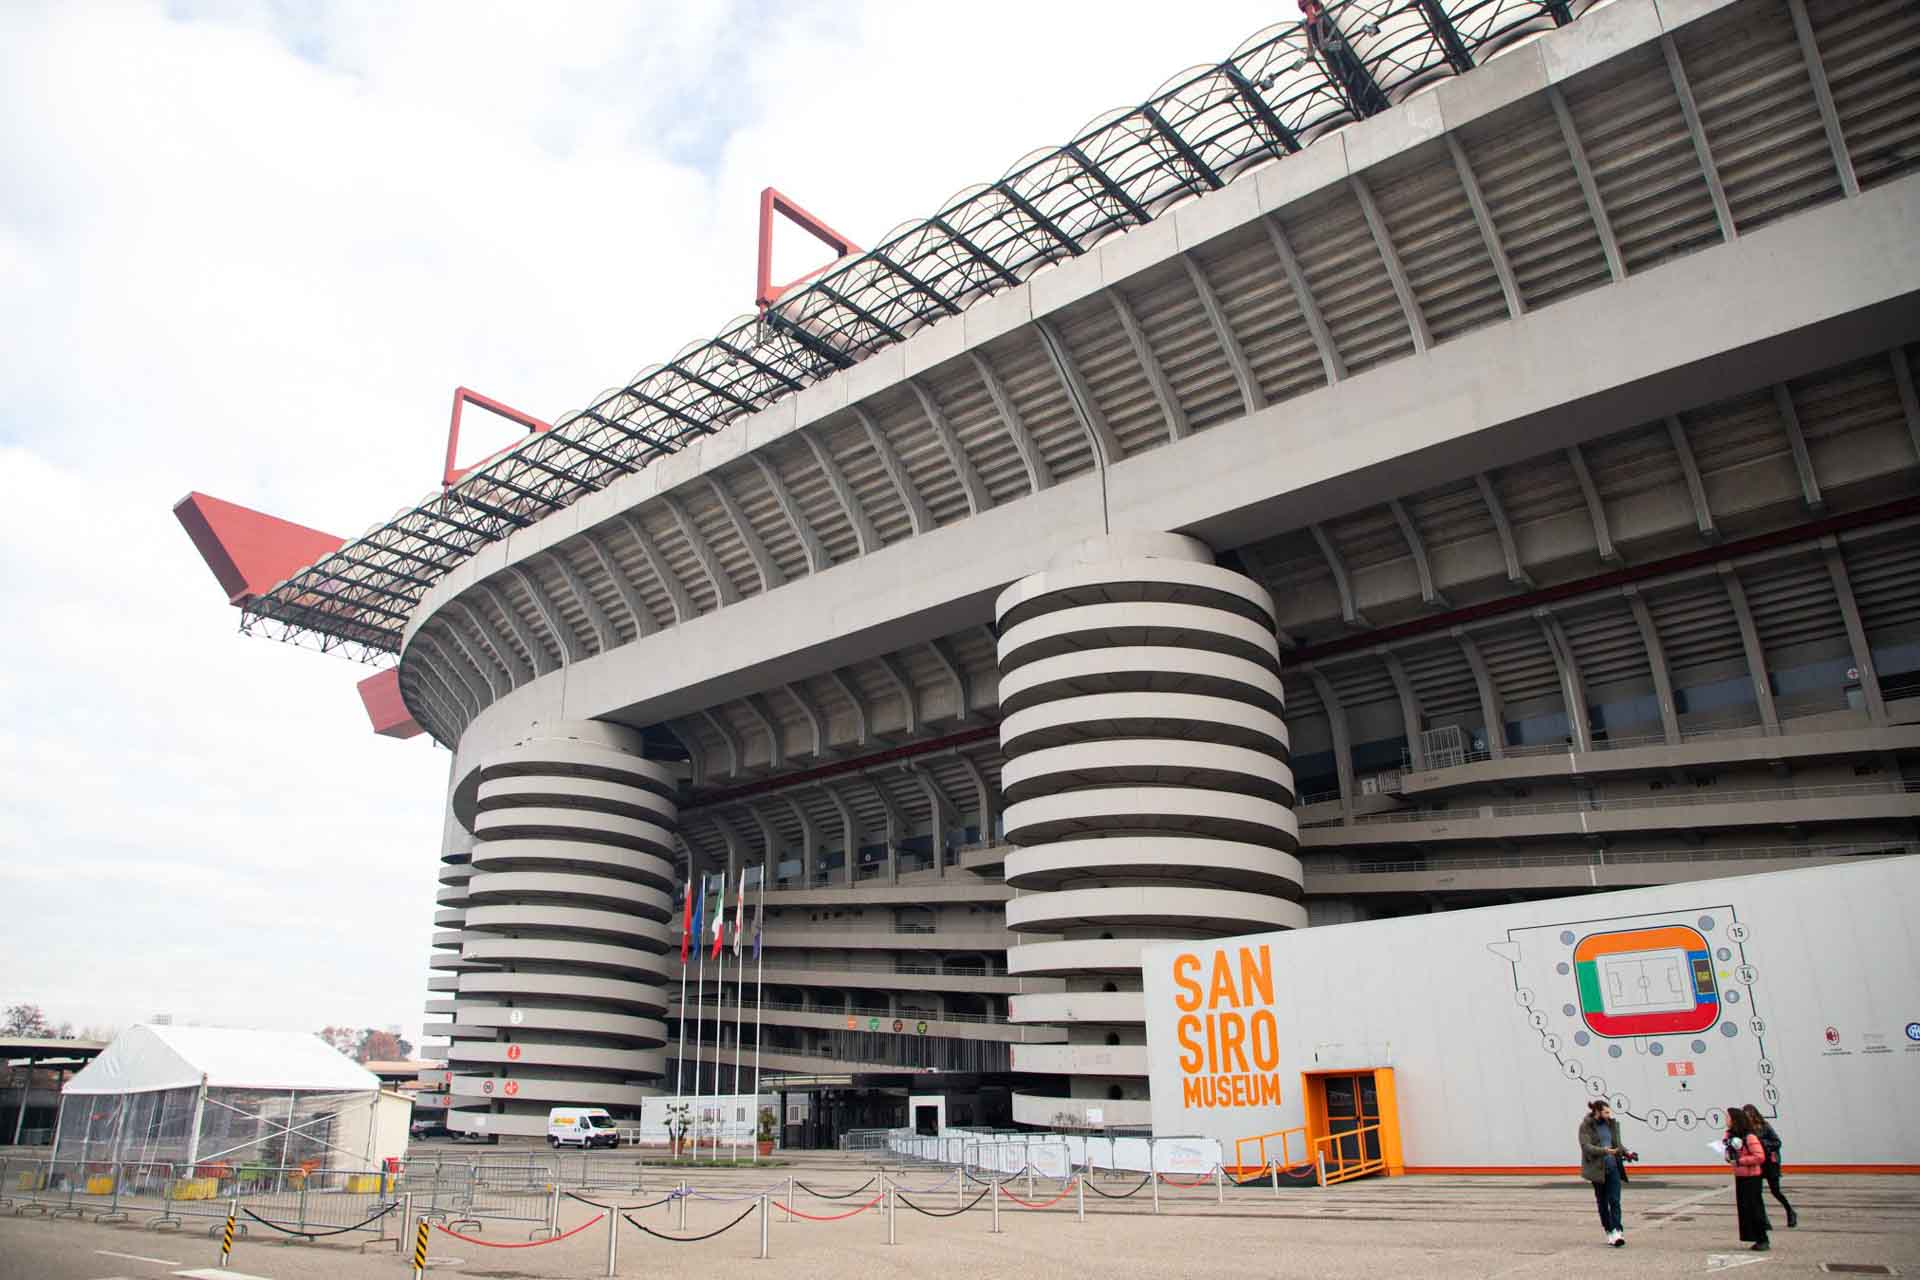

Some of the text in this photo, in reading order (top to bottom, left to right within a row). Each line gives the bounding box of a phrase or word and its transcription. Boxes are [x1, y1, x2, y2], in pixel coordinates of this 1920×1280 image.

[1733, 927, 1743, 937] 15
[1173, 945, 1274, 1012] SAN
[1742, 970, 1752, 981] 14
[1535, 1015, 1541, 1025] 2
[1752, 1021, 1762, 1032] 13
[1178, 1009, 1279, 1074] SIRO
[1549, 1038, 1555, 1049] 3
[1570, 1064, 1575, 1074] 4
[1760, 1063, 1771, 1074] 12
[1593, 1080, 1599, 1091] 5
[1183, 1074, 1281, 1109] MUSEUM
[1766, 1089, 1776, 1100] 11
[1616, 1098, 1622, 1109] 6
[1653, 1115, 1660, 1126] 7
[1683, 1114, 1689, 1125] 8
[1713, 1113, 1719, 1124] 9
